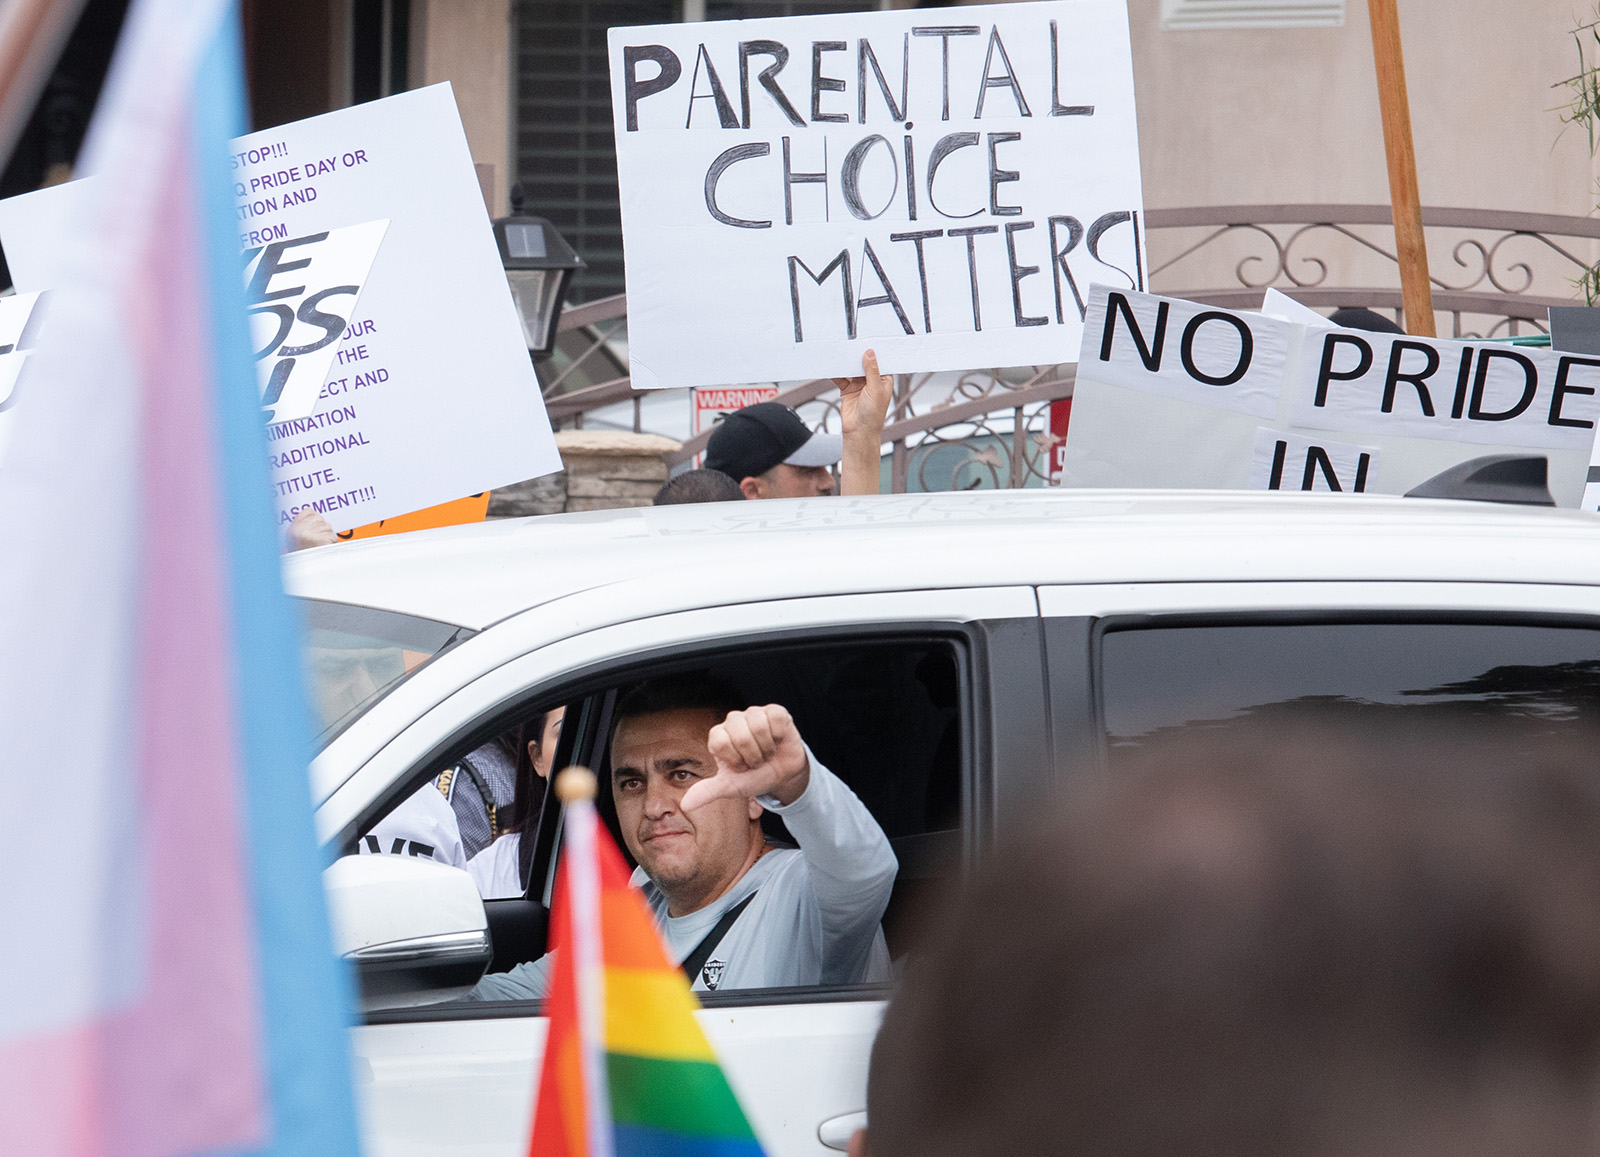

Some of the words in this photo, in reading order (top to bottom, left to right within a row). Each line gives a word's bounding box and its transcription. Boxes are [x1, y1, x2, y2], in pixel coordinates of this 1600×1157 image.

[623, 19, 1095, 131] PARENTAL
[229, 141, 289, 170] STOP!!!
[249, 166, 302, 193] PRIDE
[304, 156, 337, 178] DAY
[342, 149, 368, 168] OR
[236, 196, 278, 221] TION
[282, 187, 317, 208] AND
[240, 223, 288, 249] FROM
[337, 344, 369, 366] THE
[1099, 292, 1254, 387] NO
[1314, 332, 1600, 430] PRIDE
[354, 368, 389, 390] AND
